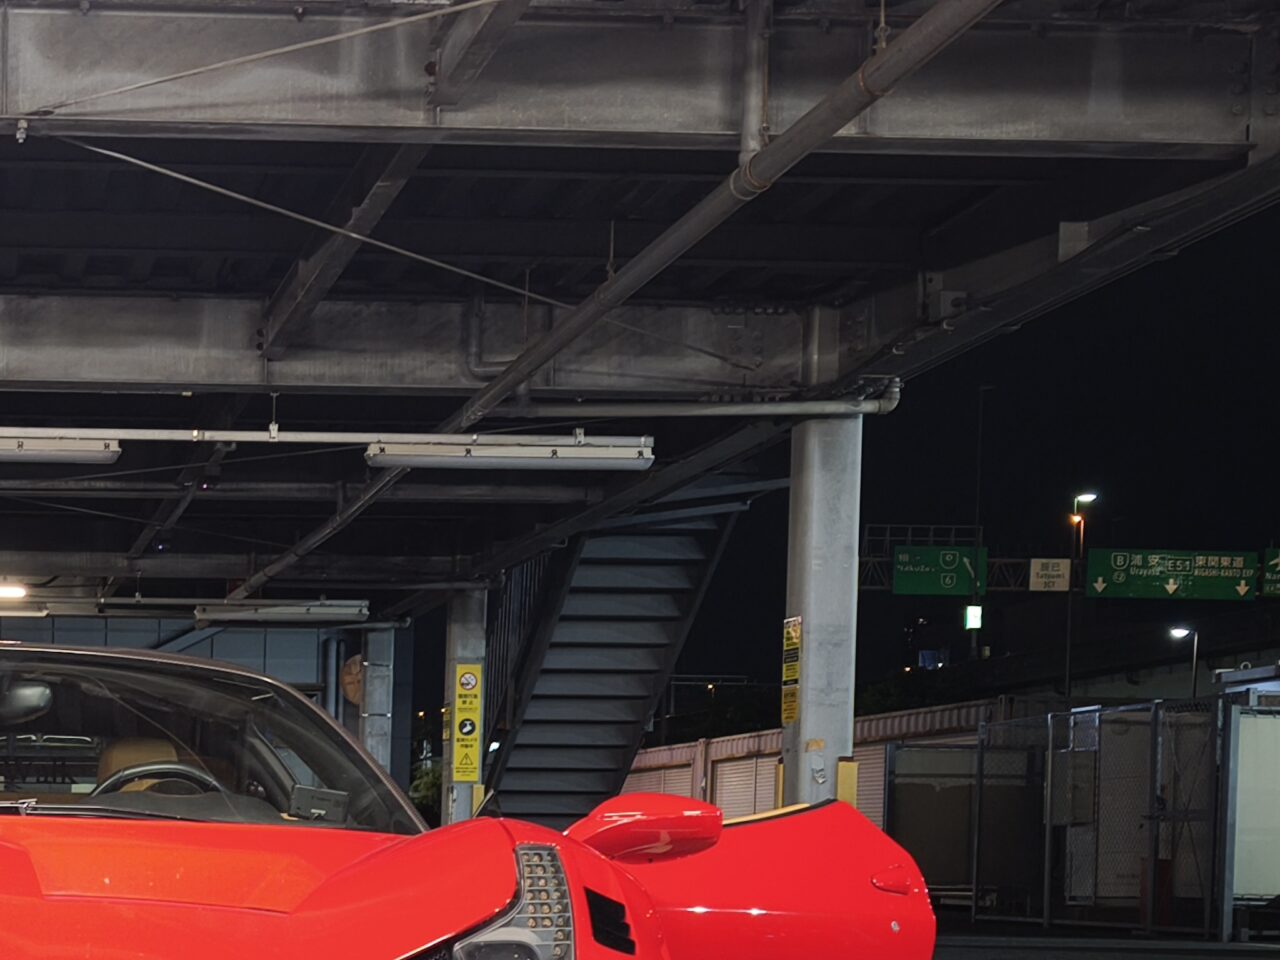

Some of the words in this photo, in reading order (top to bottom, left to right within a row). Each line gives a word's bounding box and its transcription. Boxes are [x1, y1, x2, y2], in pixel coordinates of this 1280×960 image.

[1116, 555, 1124, 566] B
[1167, 559, 1191, 572] E51
[1195, 556, 1244, 568] 東関東道
